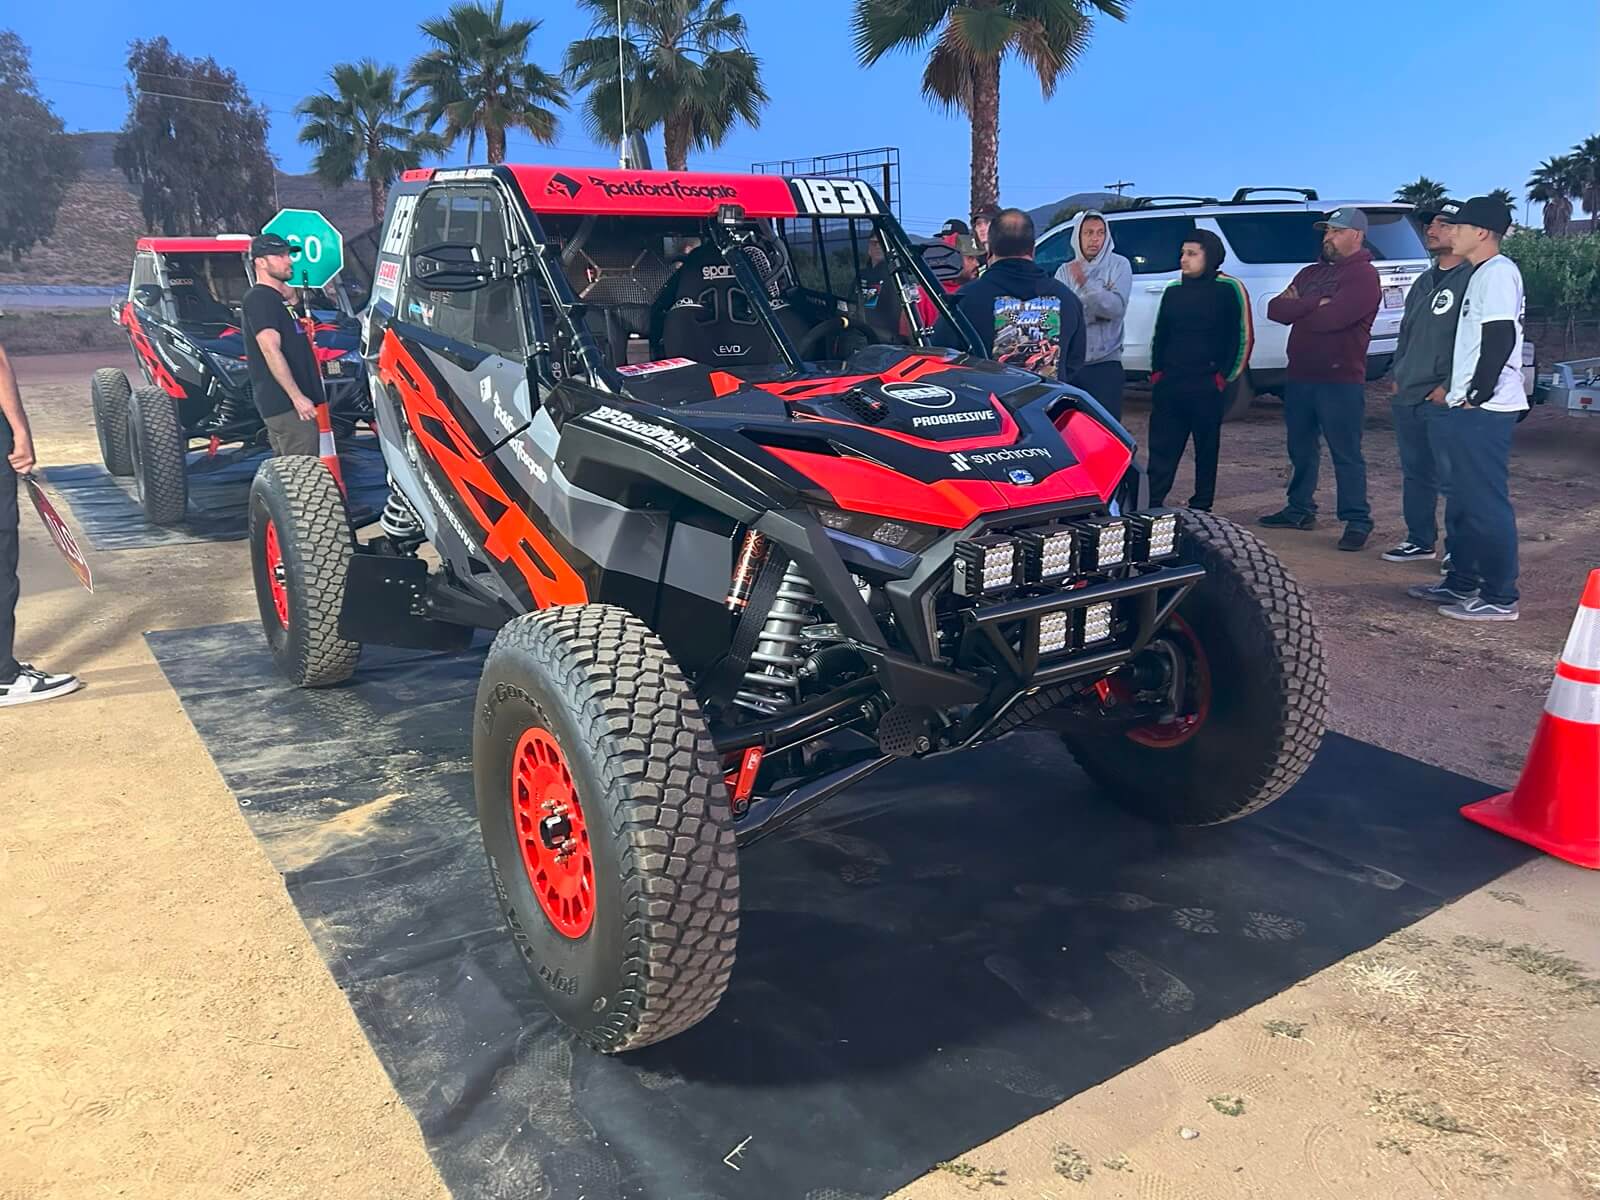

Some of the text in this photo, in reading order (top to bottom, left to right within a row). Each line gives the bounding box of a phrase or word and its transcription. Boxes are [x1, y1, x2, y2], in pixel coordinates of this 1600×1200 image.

[790, 178, 880, 214] 1831
[719, 345, 741, 353] EVO
[590, 405, 692, 454] BFGoodrich
[912, 409, 996, 428] PROGRESSIVE
[970, 447, 1052, 466] synchrony
[423, 471, 476, 555] PROGRESSIVE
